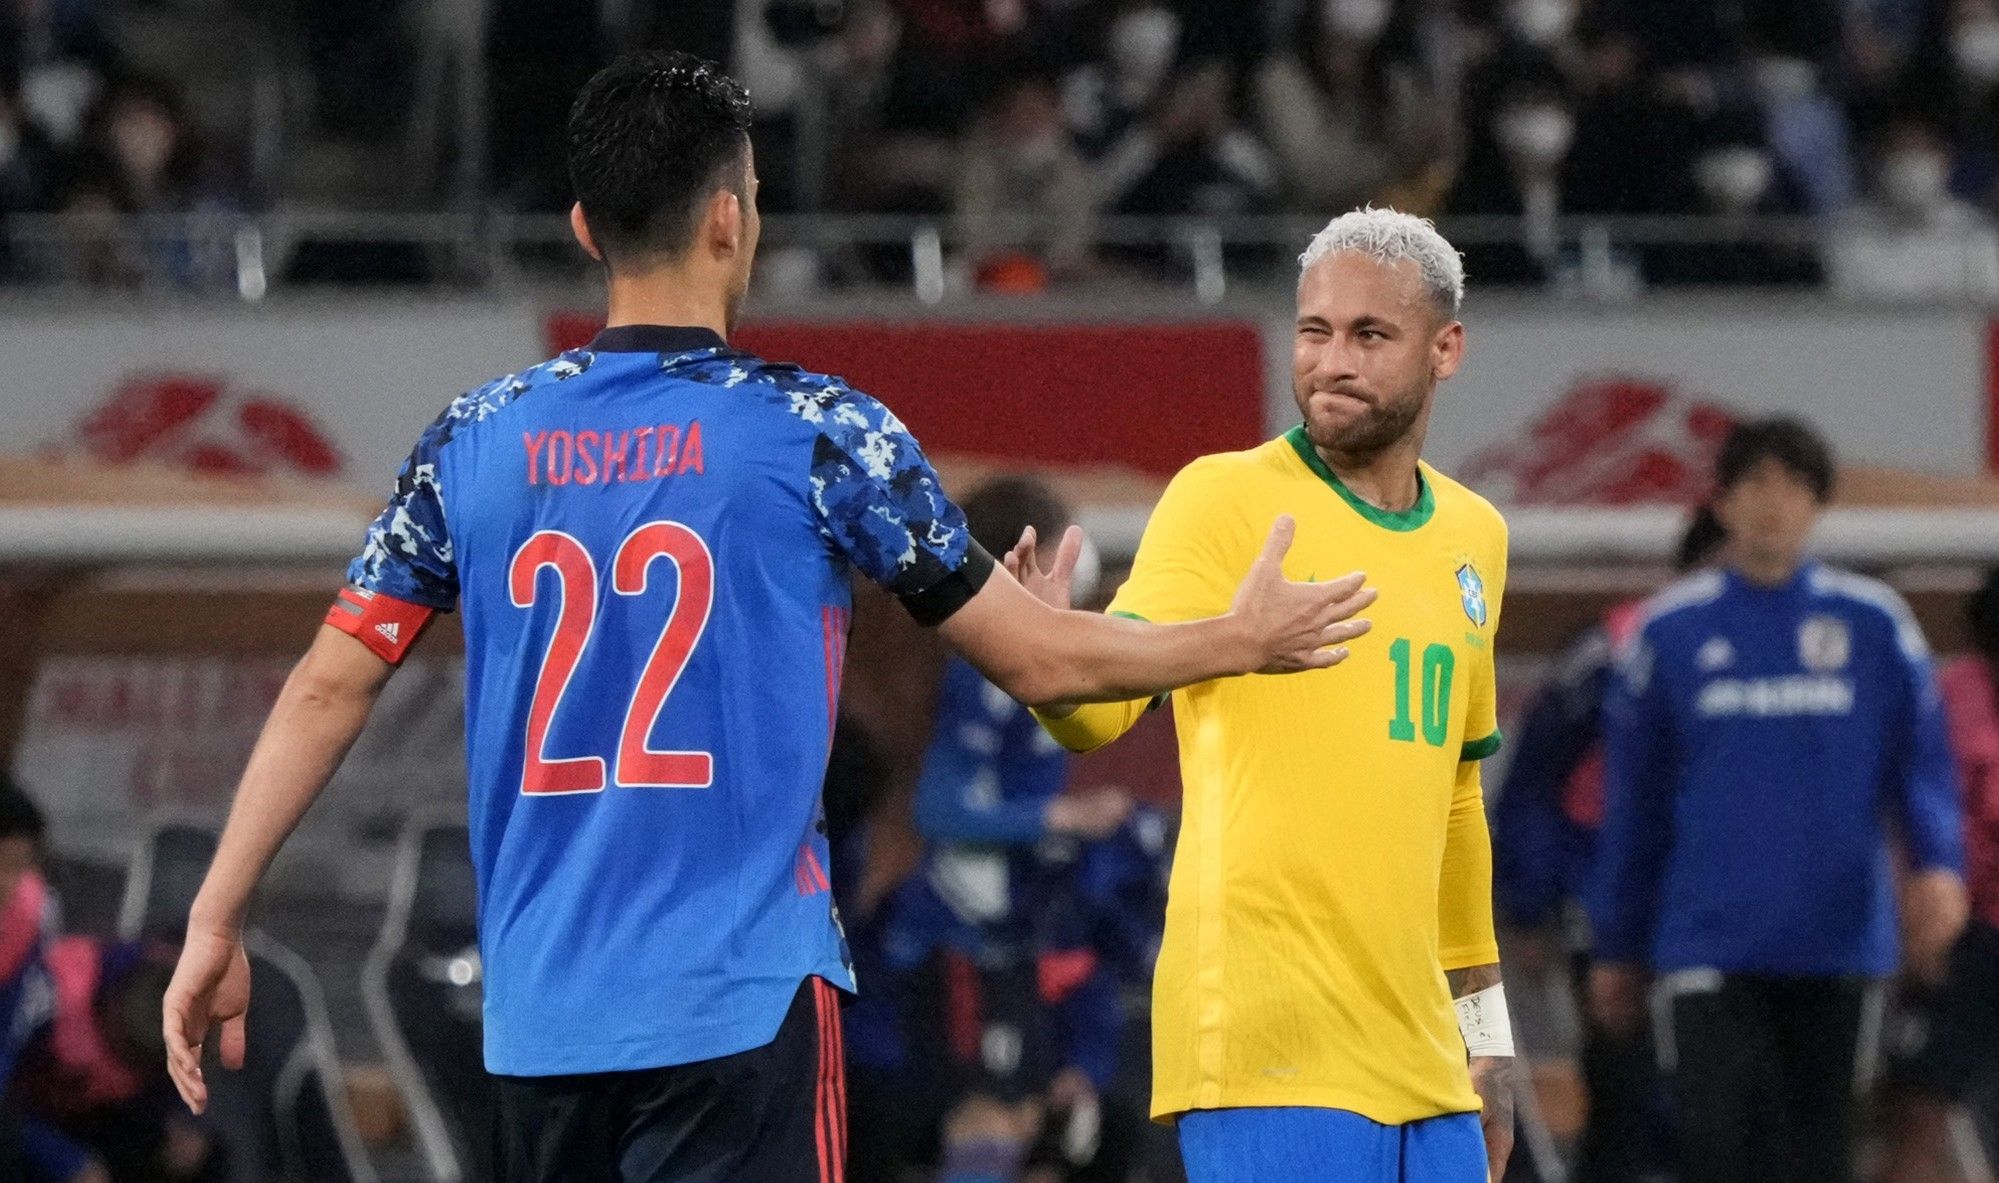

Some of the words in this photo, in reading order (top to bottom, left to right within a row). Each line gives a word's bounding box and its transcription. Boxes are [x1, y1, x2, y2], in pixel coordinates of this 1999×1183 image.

[523, 421, 705, 486] YOSHIDA
[508, 520, 714, 796] 22
[1388, 637, 1455, 747] 10
